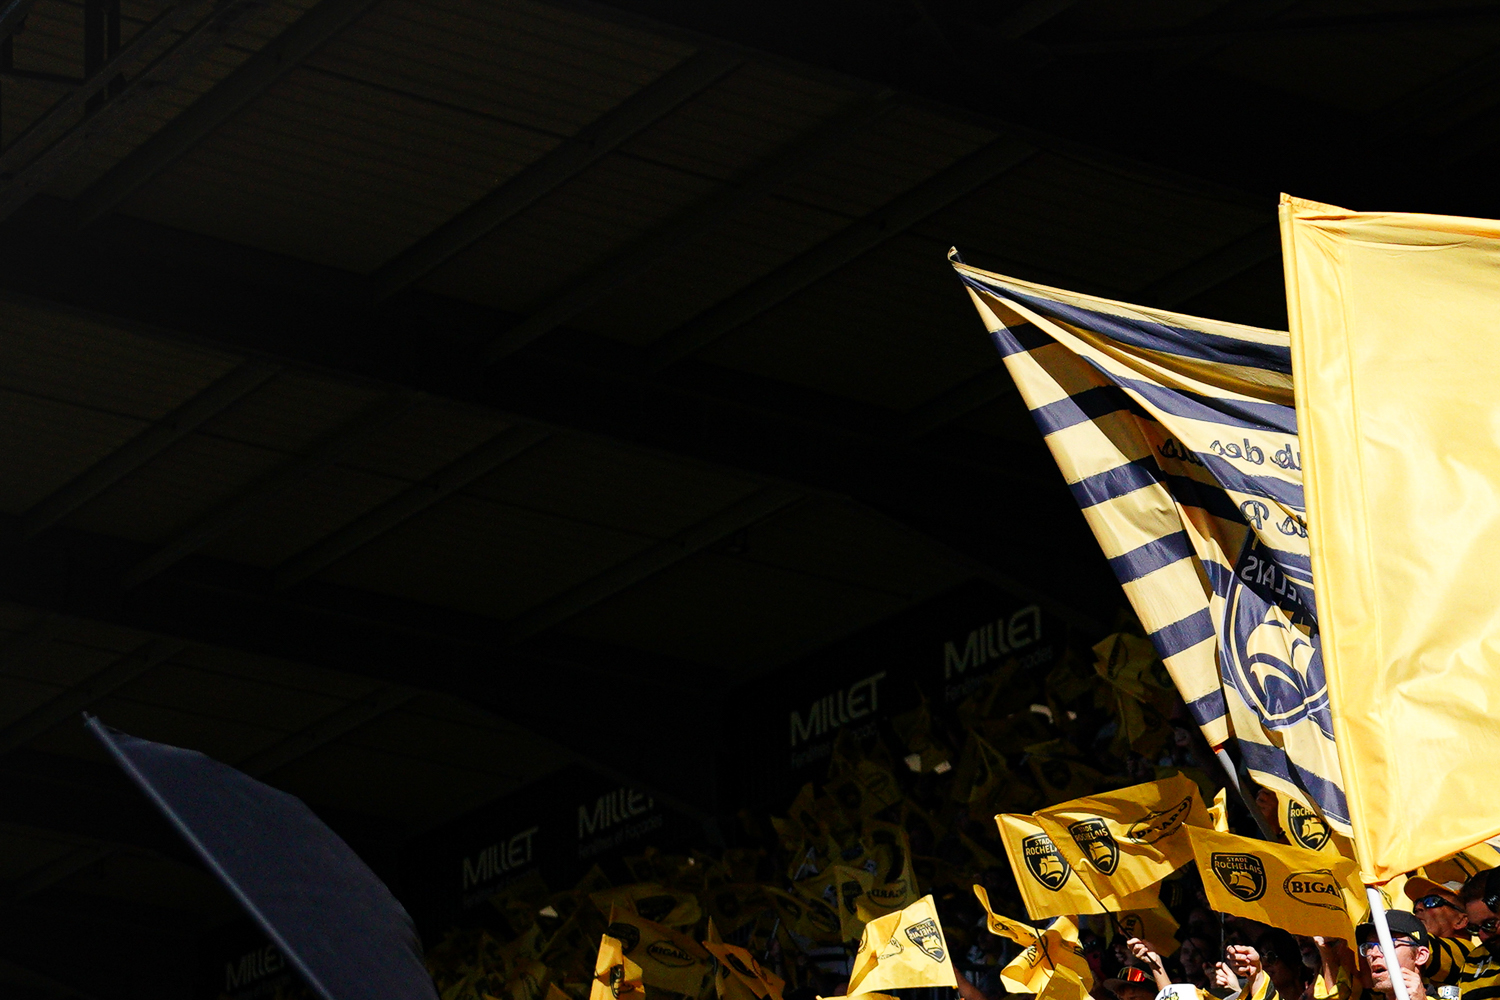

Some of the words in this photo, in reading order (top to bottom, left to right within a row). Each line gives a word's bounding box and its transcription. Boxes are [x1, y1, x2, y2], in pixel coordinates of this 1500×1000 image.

[943, 603, 1042, 680] MILLET
[789, 669, 888, 748] MILLET
[461, 825, 540, 891] MILLET
[1024, 844, 1060, 857] ROCHEL
[1213, 860, 1263, 875] ROCHELAIS
[1226, 855, 1251, 865] STADE
[1290, 880, 1337, 897] BIGA
